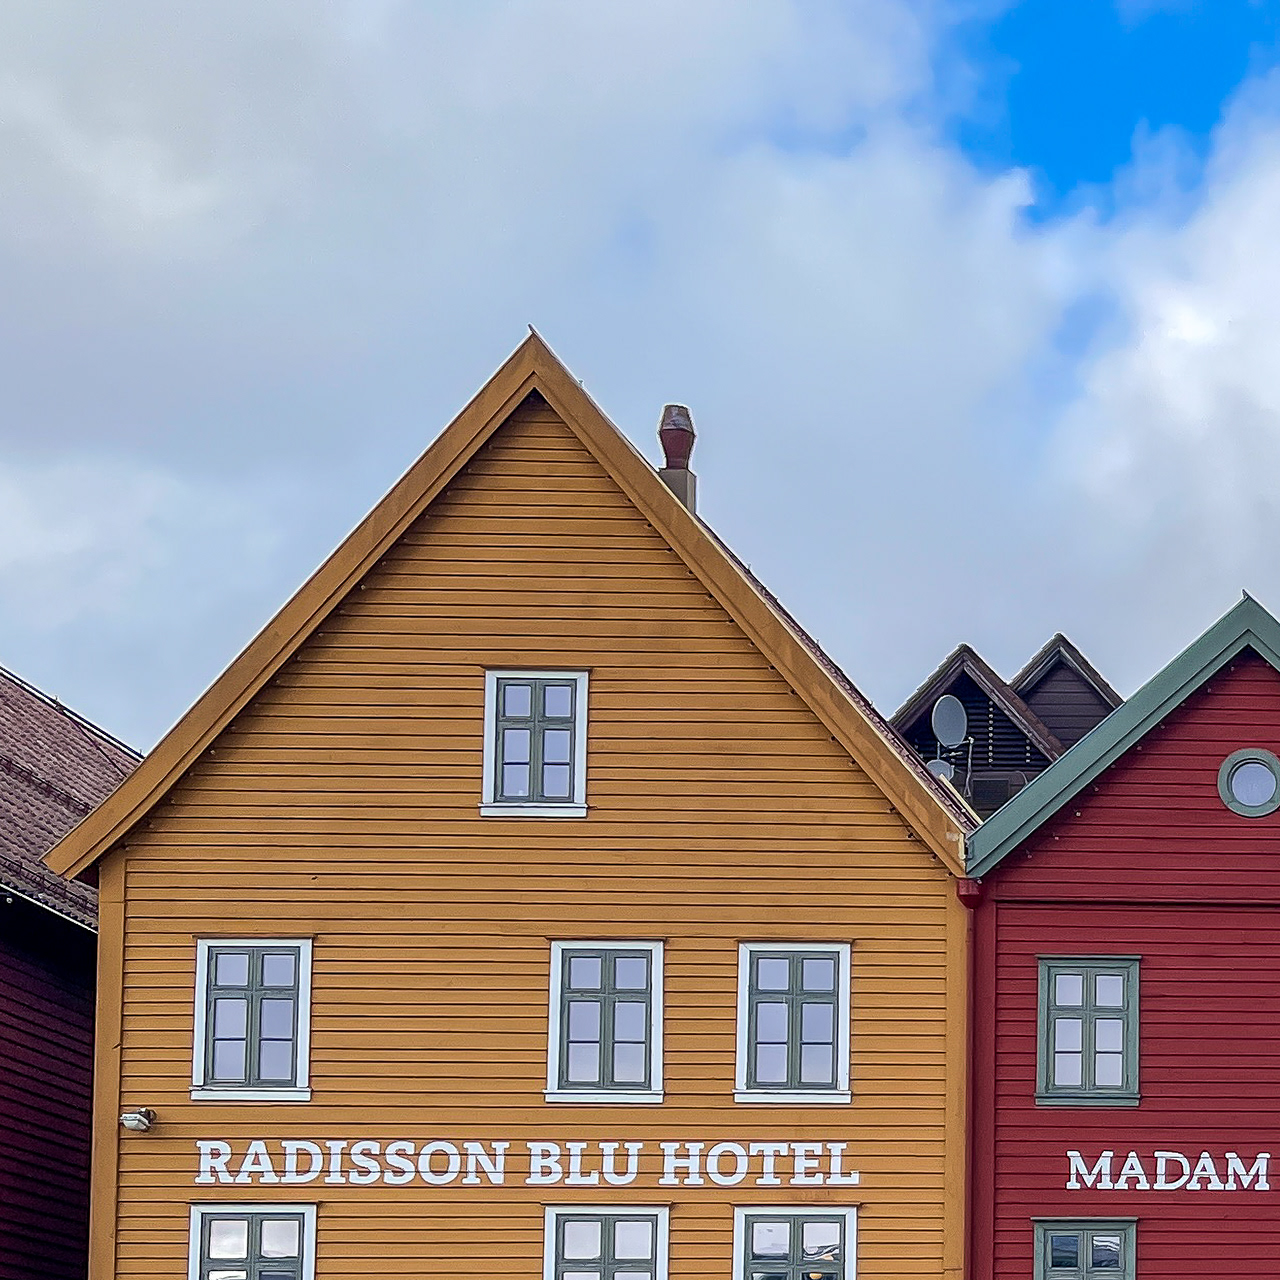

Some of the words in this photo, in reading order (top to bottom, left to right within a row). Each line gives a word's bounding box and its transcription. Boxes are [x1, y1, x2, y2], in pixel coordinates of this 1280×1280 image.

[194, 1139, 509, 1186] RADISSON
[526, 1141, 644, 1186] BLU
[658, 1141, 861, 1187] HOTEL
[1066, 1150, 1271, 1191] MADAM
